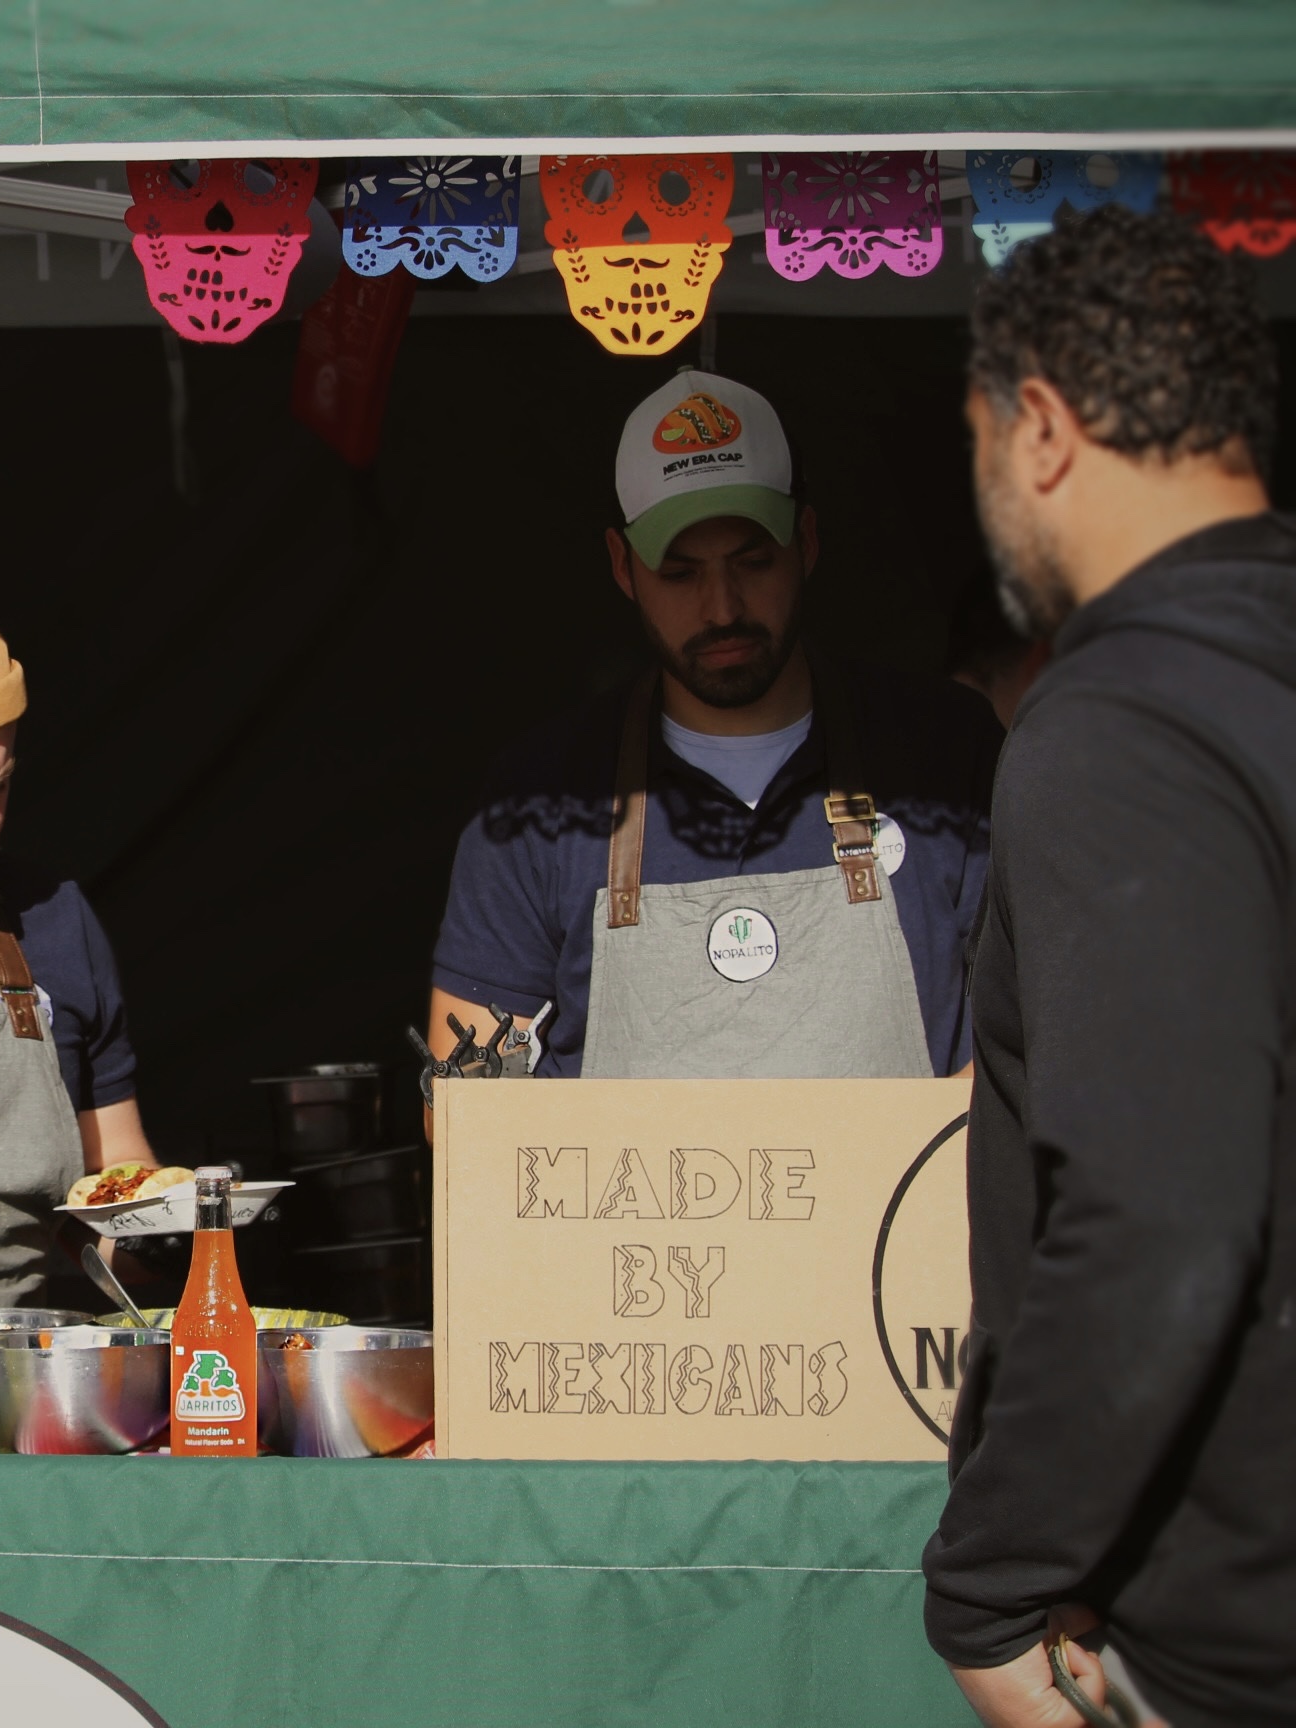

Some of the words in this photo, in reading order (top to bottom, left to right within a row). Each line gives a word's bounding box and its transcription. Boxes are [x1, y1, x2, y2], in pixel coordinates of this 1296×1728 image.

[663, 458, 689, 475] NEW
[692, 454, 716, 466] ERA
[718, 452, 742, 462] CAP
[713, 943, 774, 961] NOPALITO
[517, 1146, 816, 1221] MADE
[613, 1244, 726, 1319] BY
[488, 1340, 849, 1417] MEXICANS
[180, 1399, 237, 1412] JARRITOS
[187, 1426, 229, 1436] Mandarin
